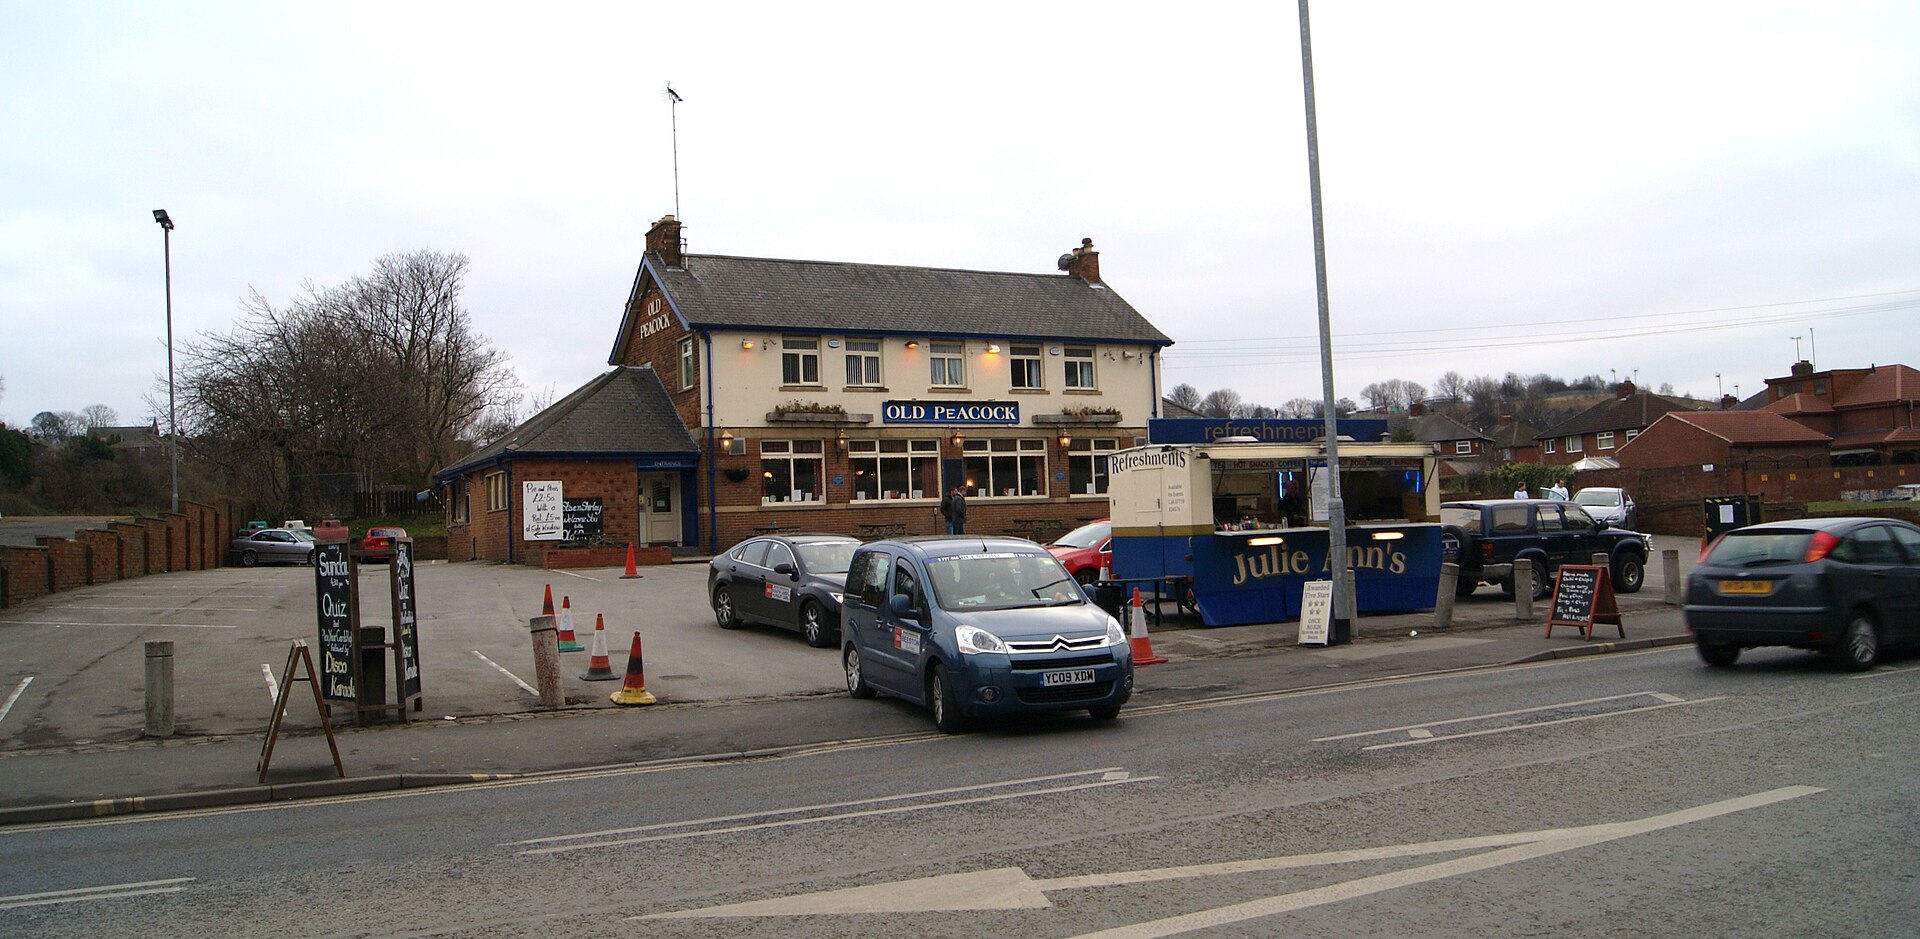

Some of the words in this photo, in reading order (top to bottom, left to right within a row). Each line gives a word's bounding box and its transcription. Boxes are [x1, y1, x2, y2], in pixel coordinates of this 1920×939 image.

[648, 298, 662, 317] OLD
[640, 312, 671, 339] PEACOCK
[886, 405, 925, 420] OLD
[934, 406, 1016, 420] PEACOCK
[1204, 421, 1327, 441] refreshment
[1112, 451, 1186, 475] Refreshments
[319, 551, 350, 577] Sunda
[1233, 543, 1310, 585] Julie
[322, 592, 347, 618] Quiz
[325, 651, 348, 674] Disco
[1045, 671, 1072, 684] YC09
[1074, 670, 1094, 682] XDM
